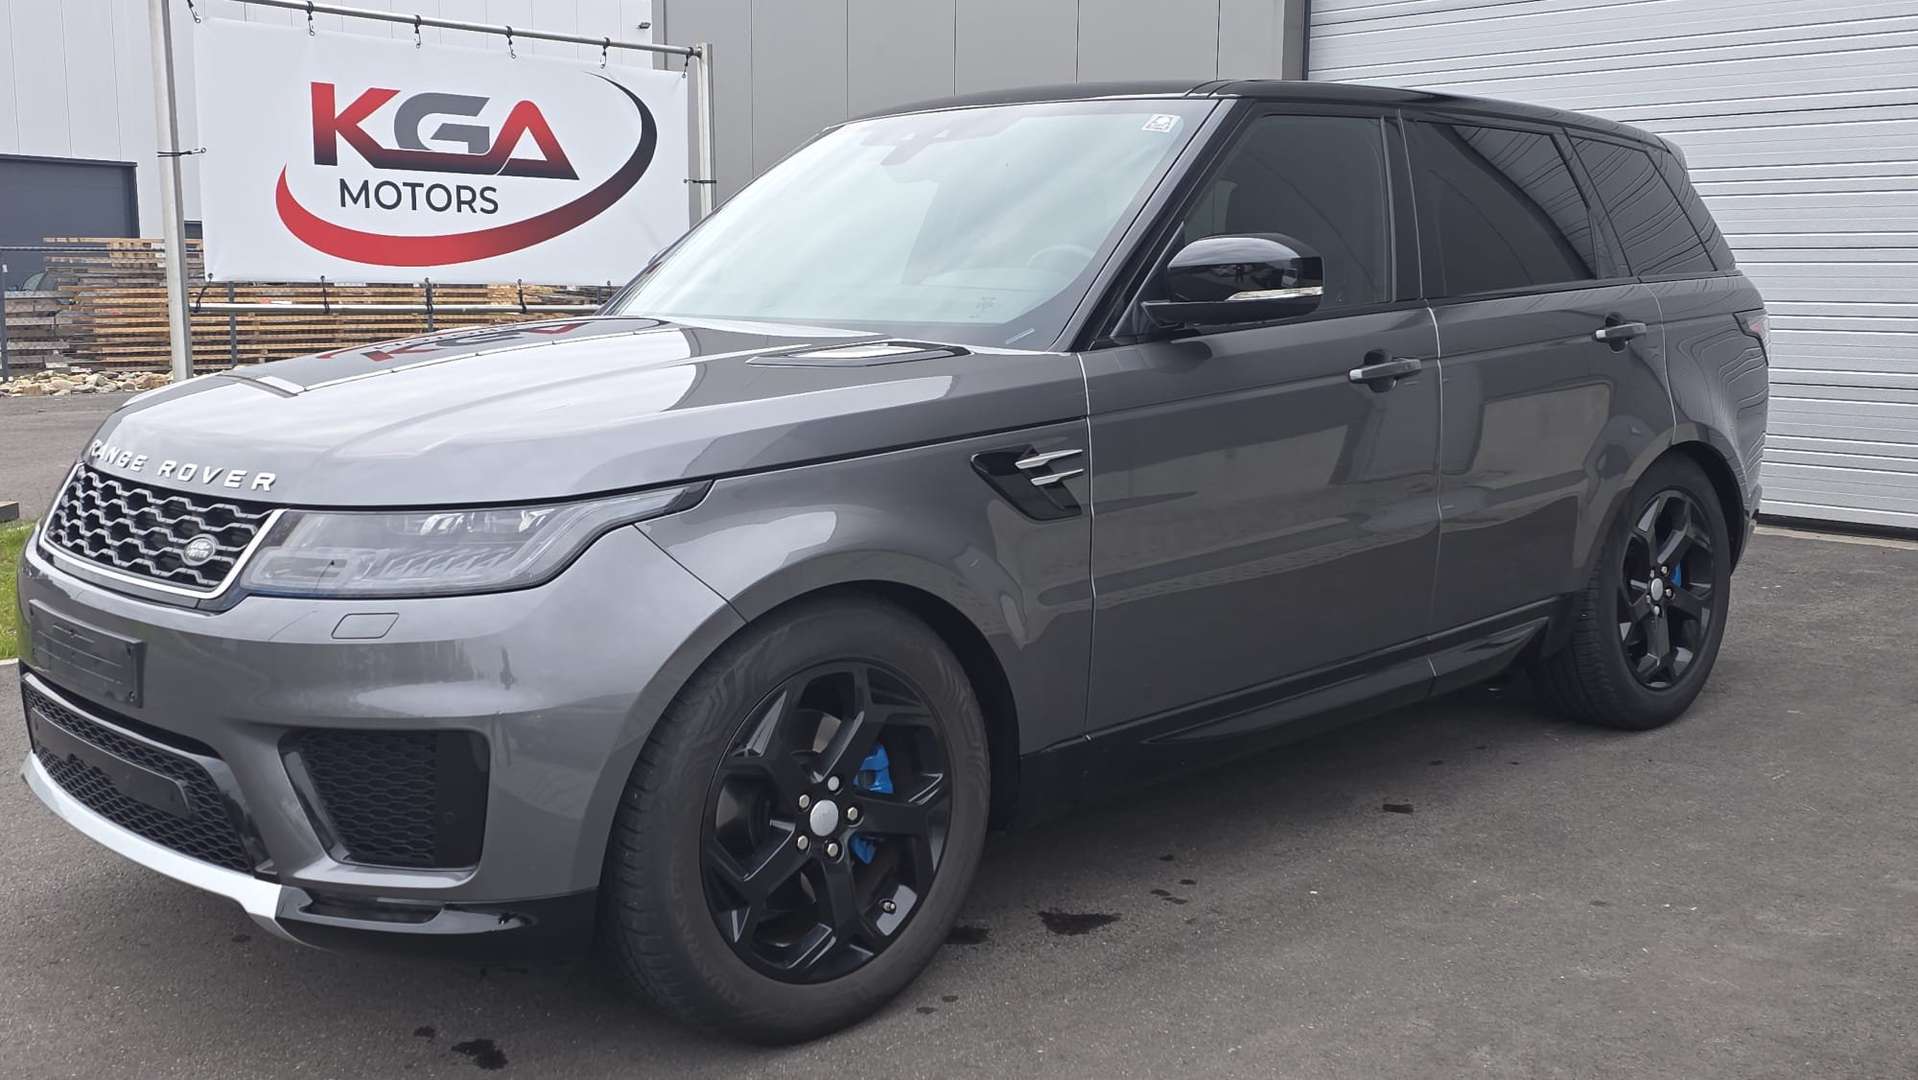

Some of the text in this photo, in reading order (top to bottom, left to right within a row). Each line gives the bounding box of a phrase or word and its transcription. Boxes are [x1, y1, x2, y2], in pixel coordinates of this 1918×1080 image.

[311, 82, 580, 180] KGA
[339, 178, 499, 215] MOTORS
[88, 439, 276, 491] RANGE ROVER
